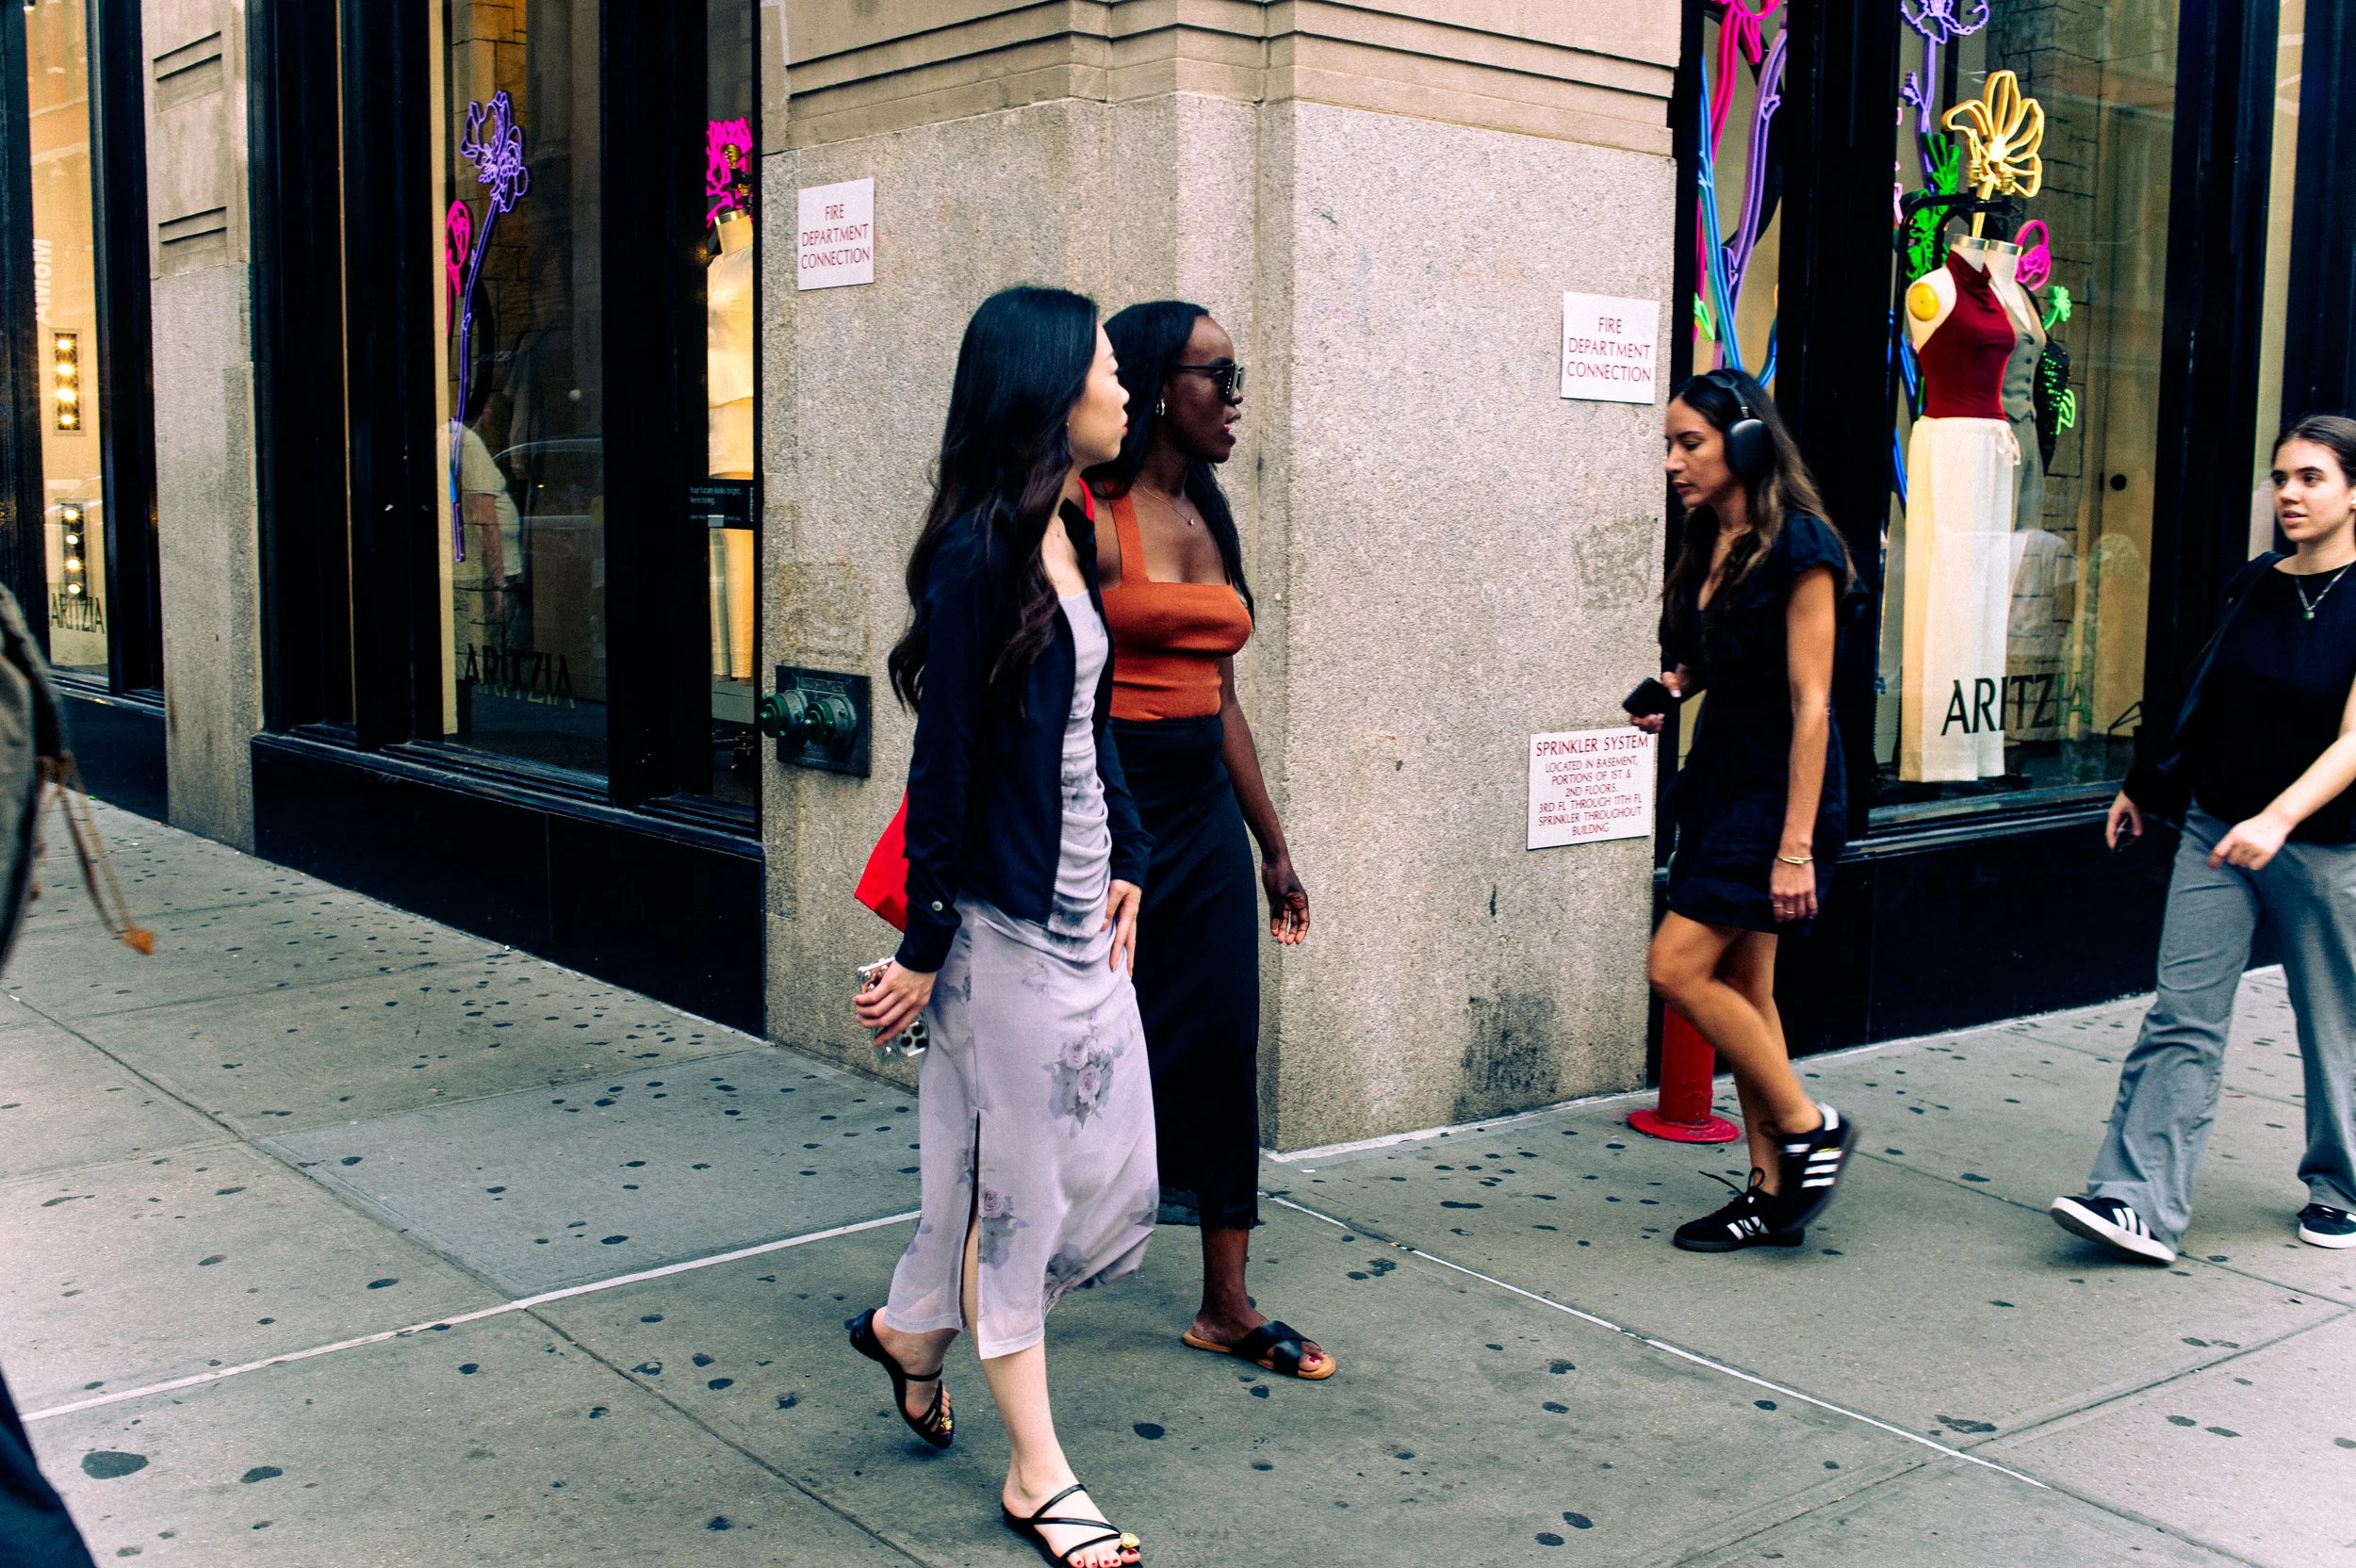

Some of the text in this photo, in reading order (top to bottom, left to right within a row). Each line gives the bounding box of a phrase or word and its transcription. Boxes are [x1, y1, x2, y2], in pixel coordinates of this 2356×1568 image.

[825, 204, 844, 220] FIRE
[802, 223, 869, 247] DEPARTMENT
[801, 246, 871, 270] CONNECTION
[1598, 317, 1622, 334] FIRE
[1569, 337, 1650, 359] DEPARTMENT
[1567, 361, 1651, 383] CONNECTION
[49, 592, 105, 634] ARITZIA
[463, 643, 577, 710] ARITZIA
[1940, 672, 2092, 736] ARITZIA
[1536, 735, 1648, 757] SPRINKLER SYSTEM
[1545, 756, 1638, 773] LOCATED IN BASEMENT,
[1551, 773, 1593, 786] PORTIONS
[1595, 771, 1607, 781] OF
[1626, 769, 1631, 778] &
[1565, 786, 1582, 797] 2ND
[1539, 793, 1642, 813] 3RD FL THROUGH 11TH FL
[1538, 806, 1643, 826] SPRINKLER THROUGHOUT
[1572, 823, 1610, 837] BUILDING
